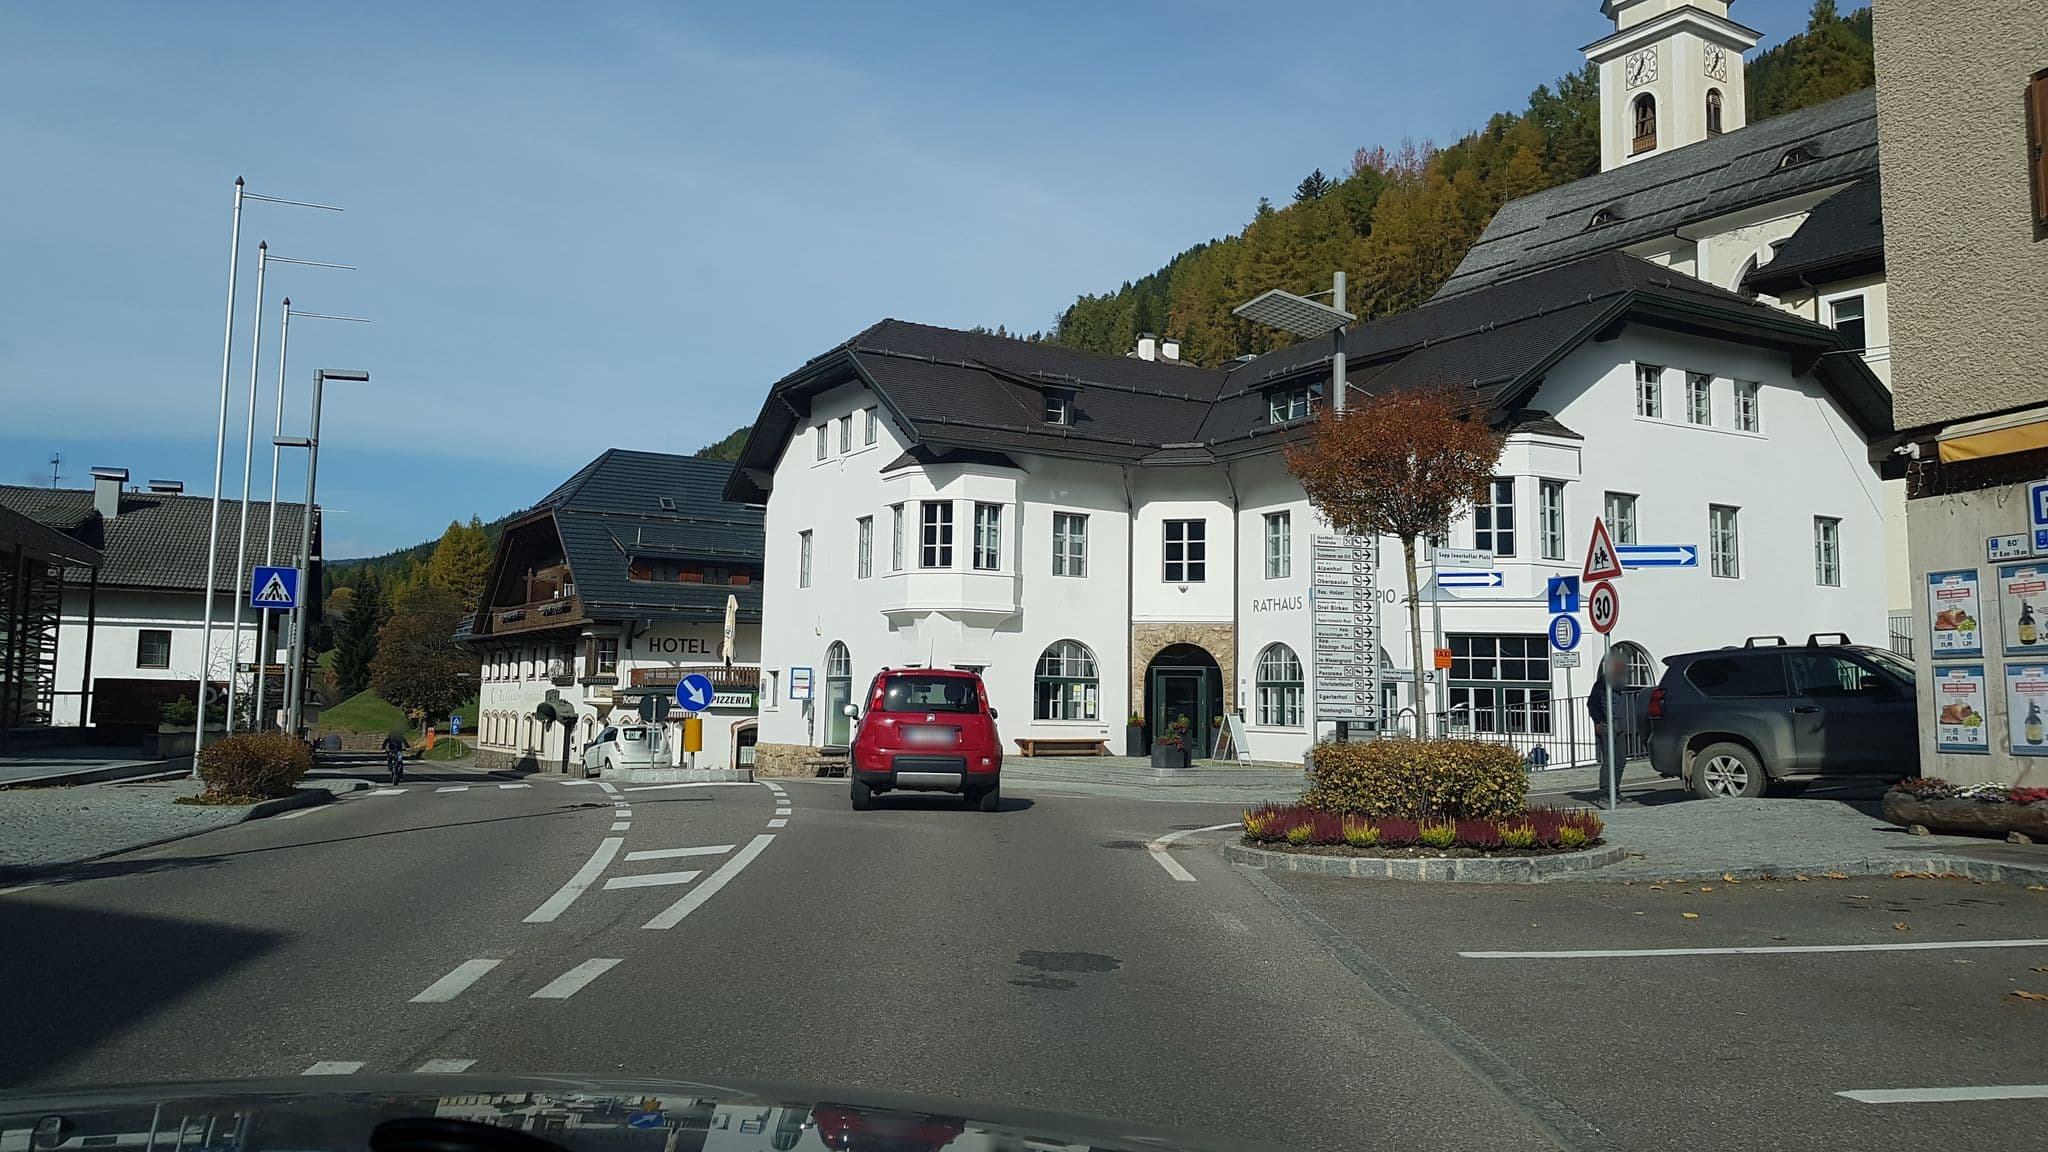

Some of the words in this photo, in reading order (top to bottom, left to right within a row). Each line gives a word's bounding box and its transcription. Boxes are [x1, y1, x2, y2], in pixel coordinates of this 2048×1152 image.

[1253, 596, 1303, 612] RATHAUS
[1595, 595, 1610, 620] 30
[649, 637, 710, 653] HOTEL
[1435, 649, 1451, 657] TAXI
[711, 695, 750, 705] PIZZERIA
